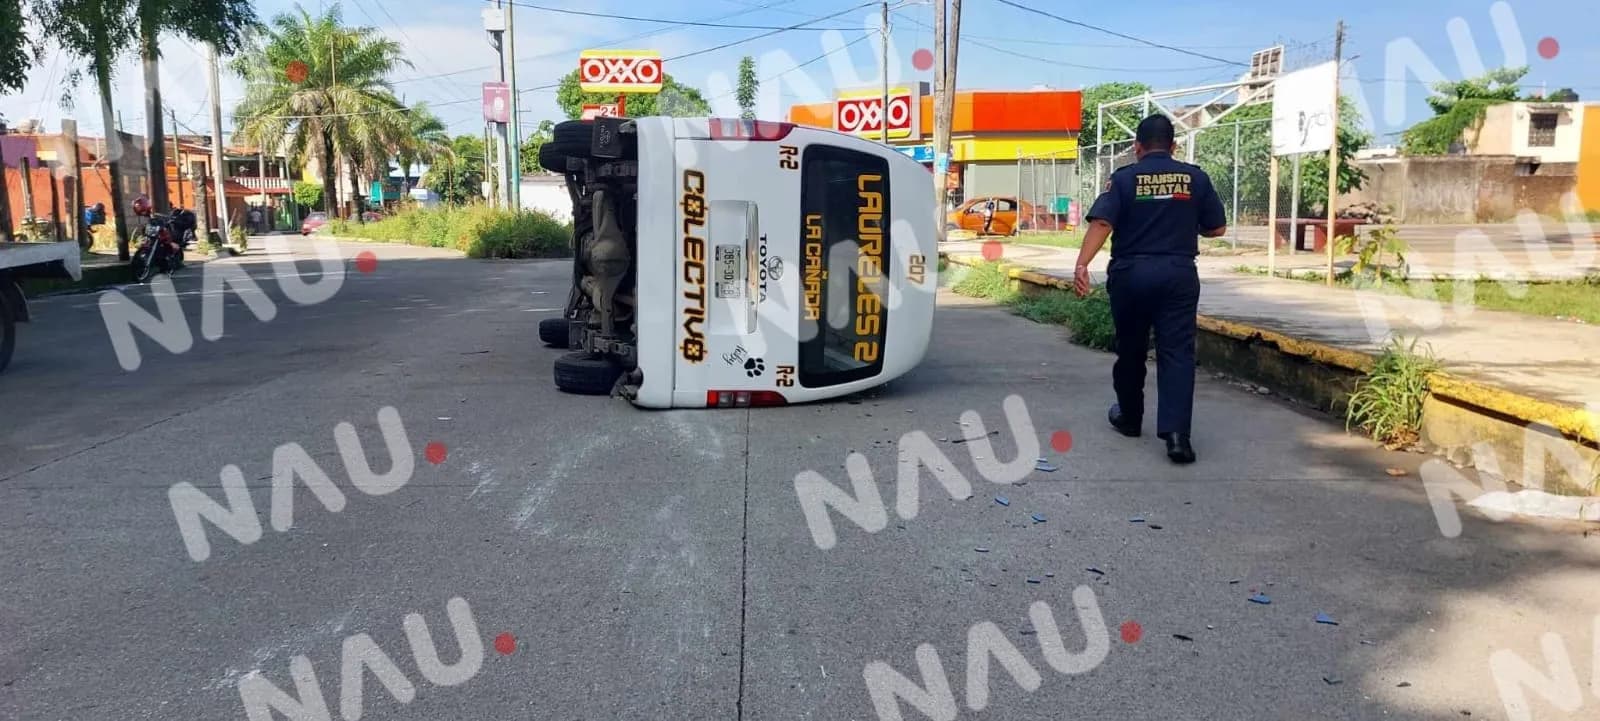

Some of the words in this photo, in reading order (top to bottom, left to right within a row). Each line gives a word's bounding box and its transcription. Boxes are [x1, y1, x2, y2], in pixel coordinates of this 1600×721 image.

[583, 58, 659, 84] OXXO
[601, 106, 617, 117] 24
[840, 98, 909, 134] OXXO
[780, 145, 798, 170] R-2
[1136, 173, 1191, 184] TRANSITO
[1136, 184, 1191, 195] ESTATAL
[805, 213, 822, 240] LA
[681, 168, 706, 364] COLECTIVO
[855, 173, 884, 336] LAURELES
[759, 233, 767, 304] TOYOTA
[803, 242, 828, 321] CAÑADA
[907, 254, 926, 285] 207
[854, 341, 878, 363] 2
[776, 365, 796, 388] R-2
